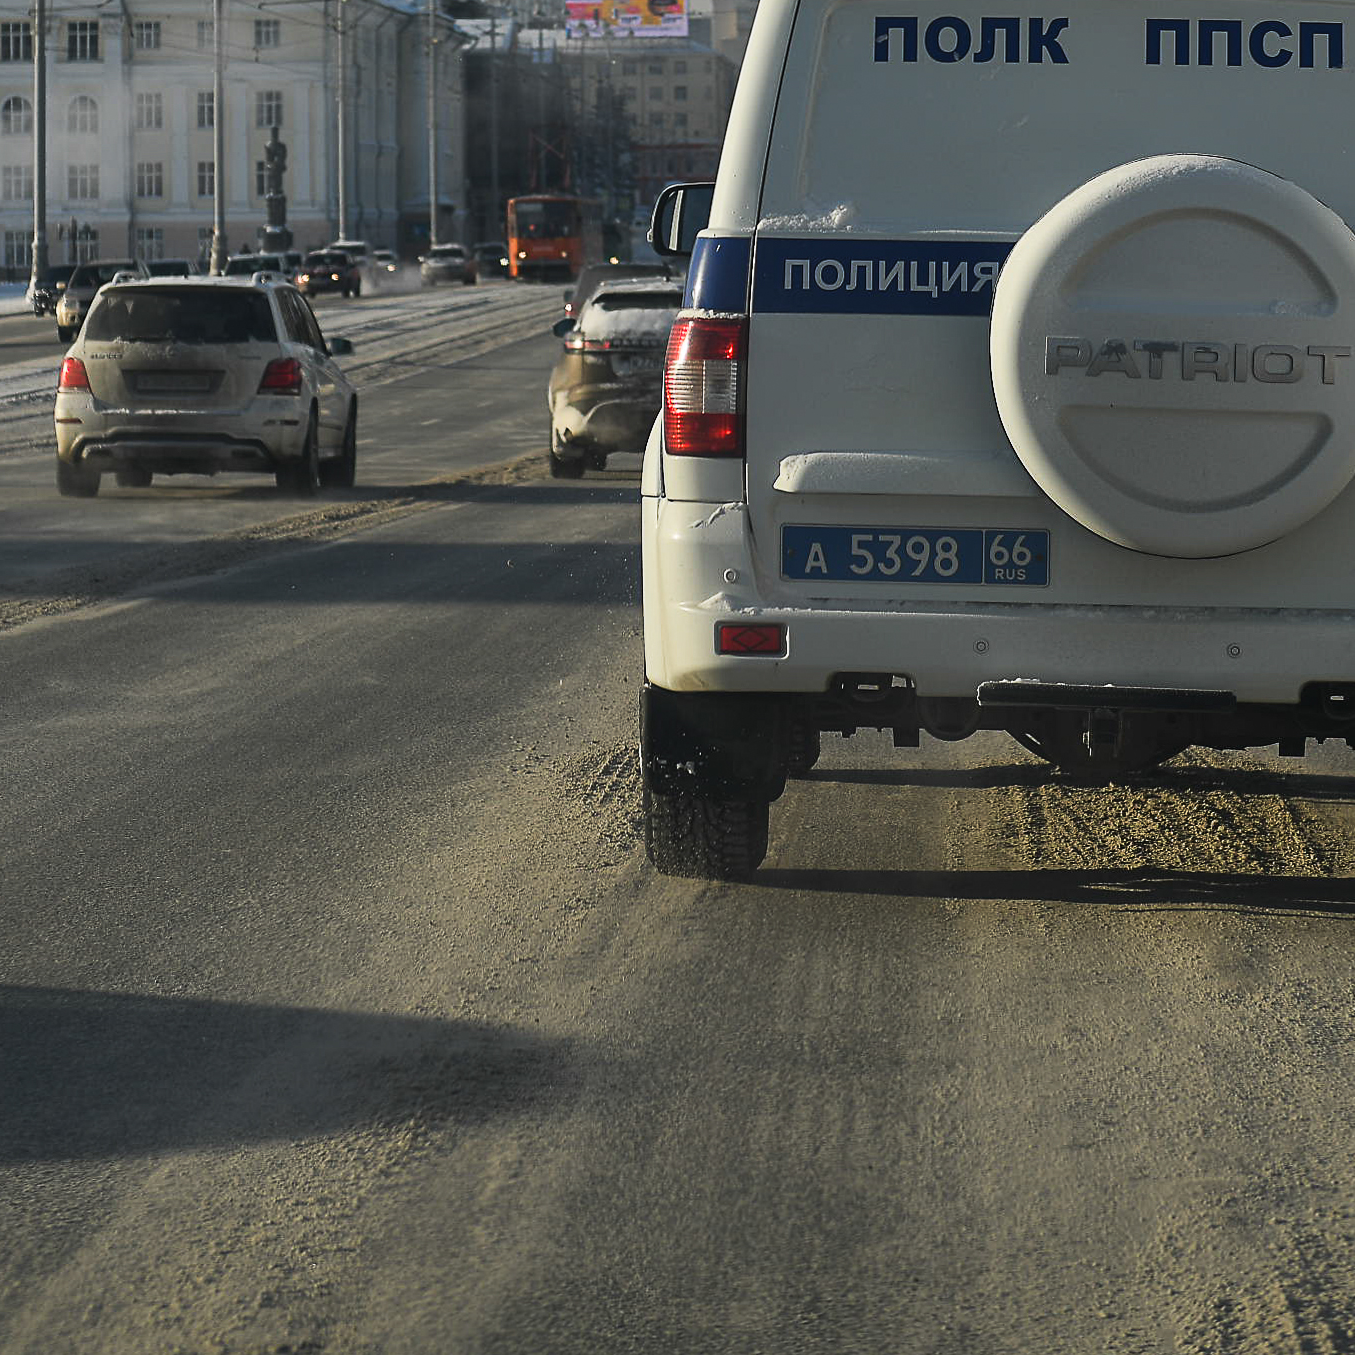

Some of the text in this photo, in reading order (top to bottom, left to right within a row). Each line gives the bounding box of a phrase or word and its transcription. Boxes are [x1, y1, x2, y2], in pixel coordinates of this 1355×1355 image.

[873, 16, 1344, 69] ПОЛК ППСП
[784, 259, 1000, 298] ПОЛИЦИЯ
[1044, 336, 1352, 386] PATRIOT
[849, 534, 959, 577] 5398
[989, 534, 1032, 566] 66
[995, 568, 1027, 581] RUS
